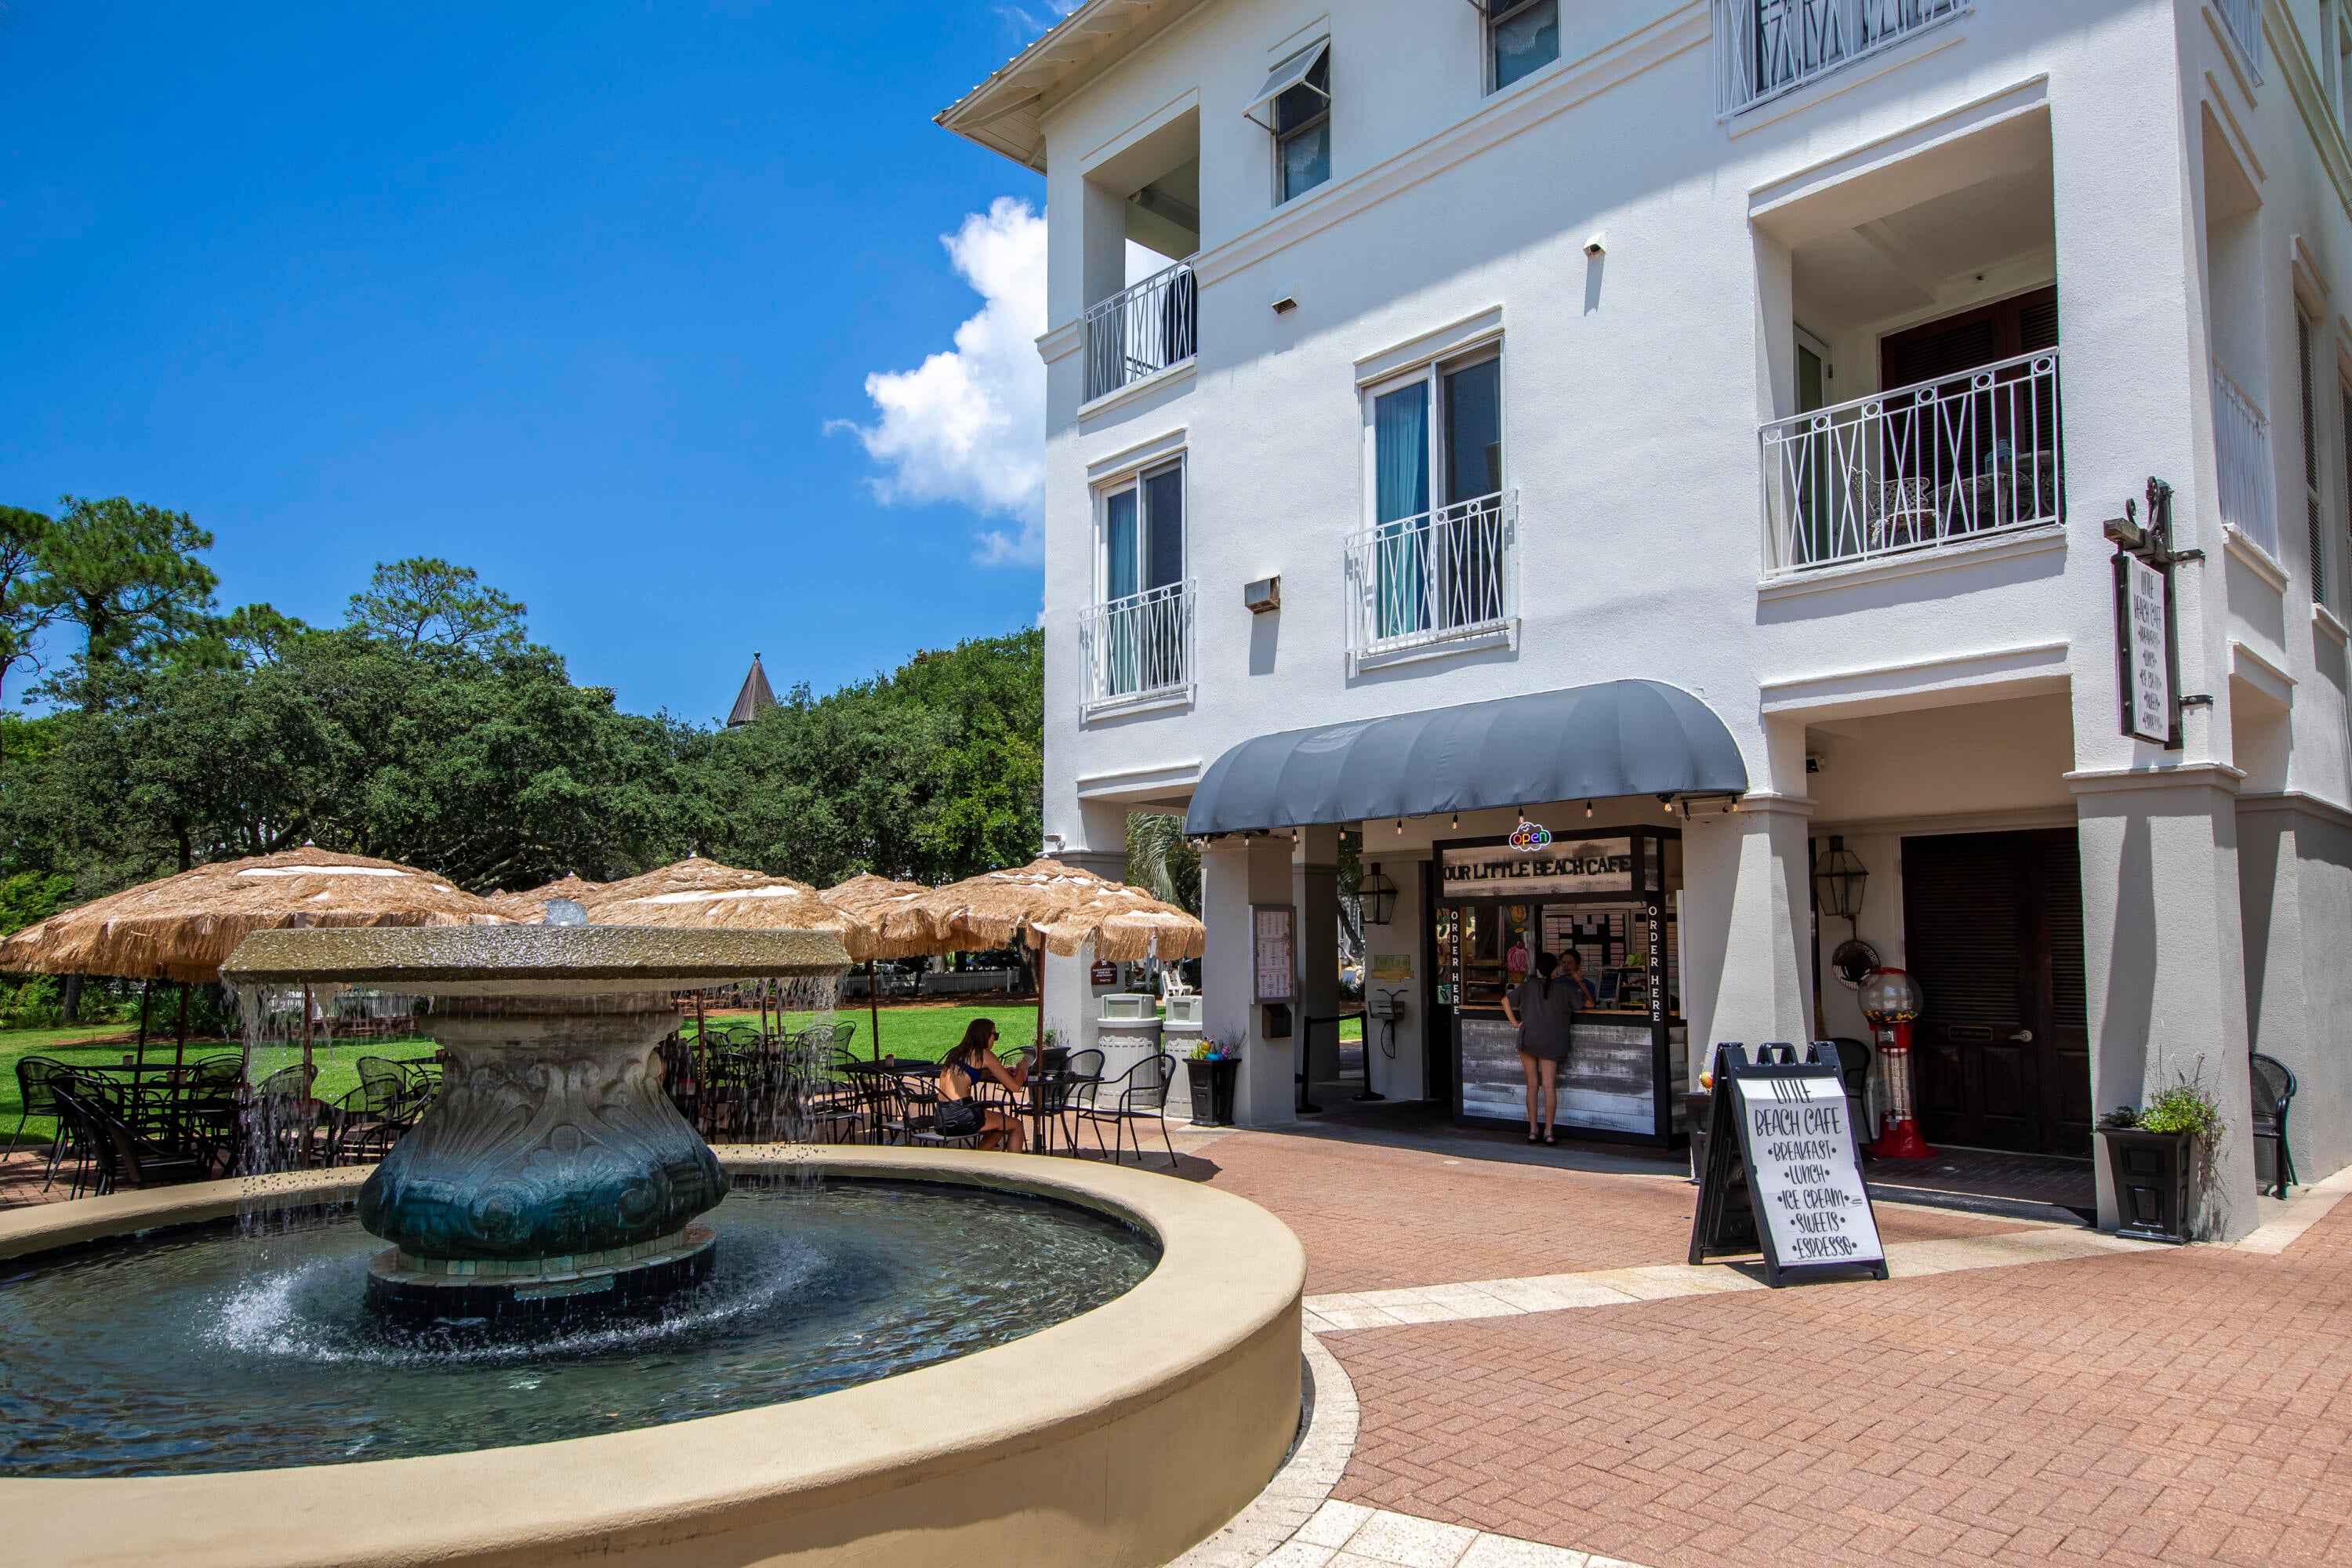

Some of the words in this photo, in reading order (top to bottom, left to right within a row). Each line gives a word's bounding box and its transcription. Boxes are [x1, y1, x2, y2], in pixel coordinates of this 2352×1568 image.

[2134, 594, 2149, 624] BEACH
[1512, 832, 1548, 846] open
[1473, 862, 1530, 880] LITTLE
[1534, 858, 1585, 877] BEACH
[1587, 855, 1632, 876] CAFE
[1649, 906, 1658, 967] ORDER
[1651, 975, 1661, 1022] HERE
[1770, 1079, 1814, 1104] LITTLE
[1755, 1109, 1801, 1137] BEACH
[1804, 1107, 1842, 1135] CAFE
[1773, 1140, 1833, 1162] BREAKFAST
[1789, 1164, 1826, 1184] LUNCH
[1781, 1190, 1799, 1210] ICE
[1803, 1189, 1846, 1208] CREAM
[1796, 1212, 1839, 1233] SWEETS
[1796, 1236, 1852, 1258] ESPRESSO
